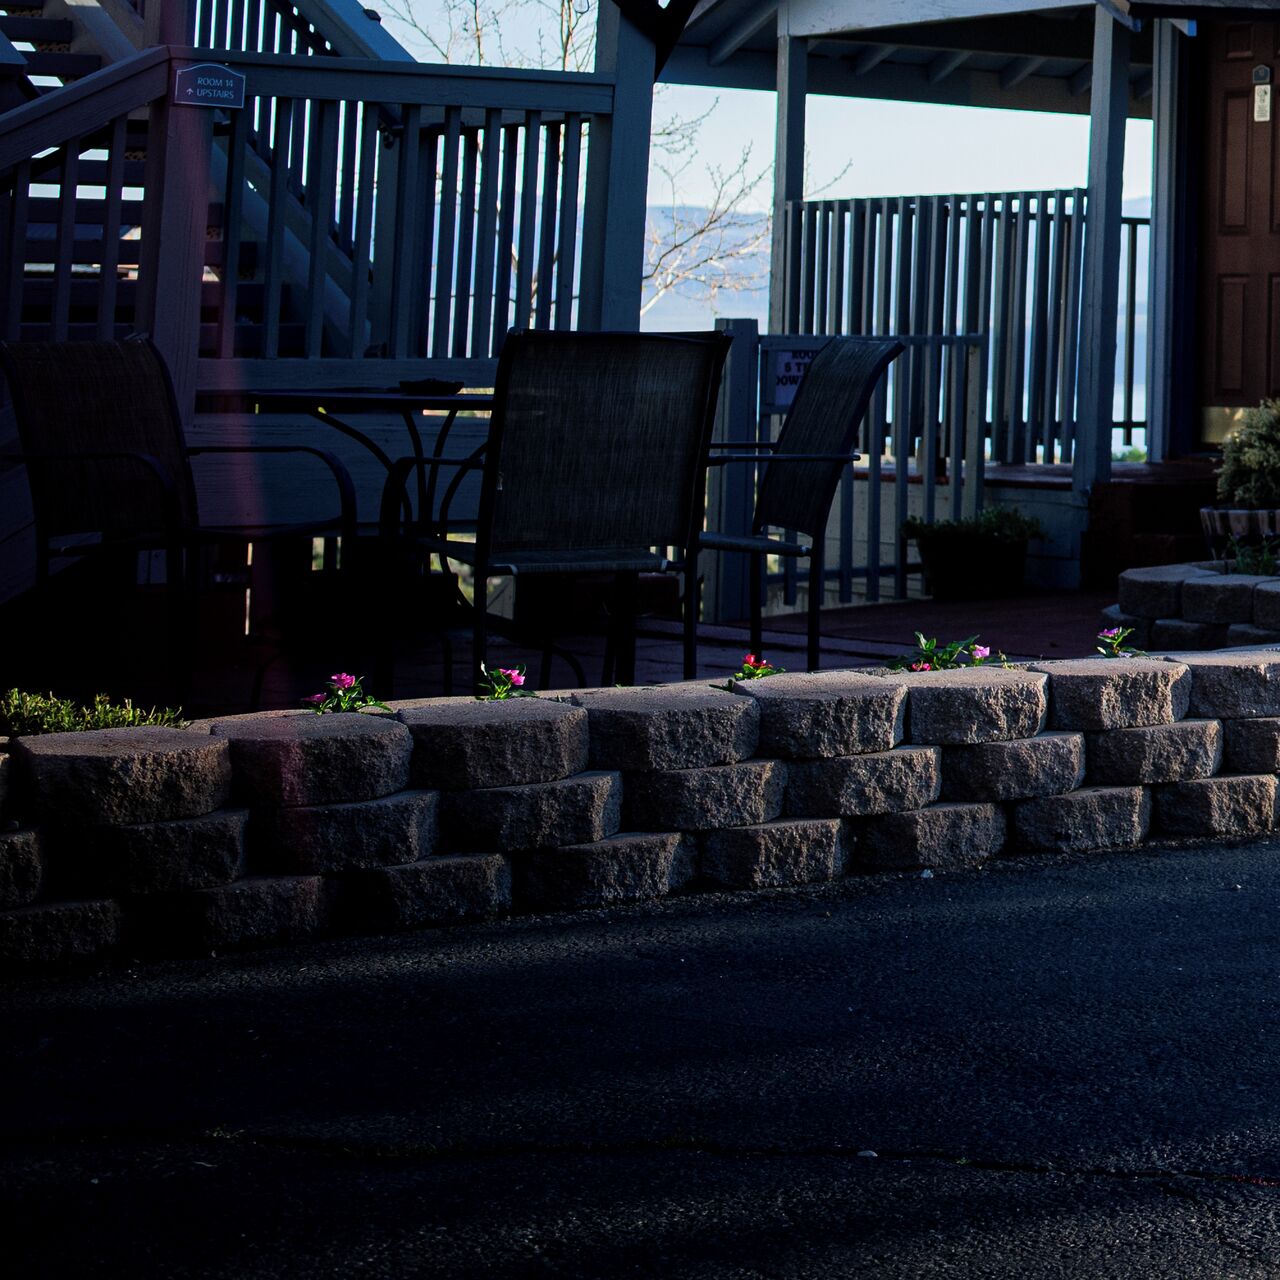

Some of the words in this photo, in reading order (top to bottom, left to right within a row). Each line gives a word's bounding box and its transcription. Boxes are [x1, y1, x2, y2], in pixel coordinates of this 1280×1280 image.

[197, 77, 223, 87] ROOM
[226, 79, 233, 87] 14
[196, 88, 234, 99] UPSTAIRS
